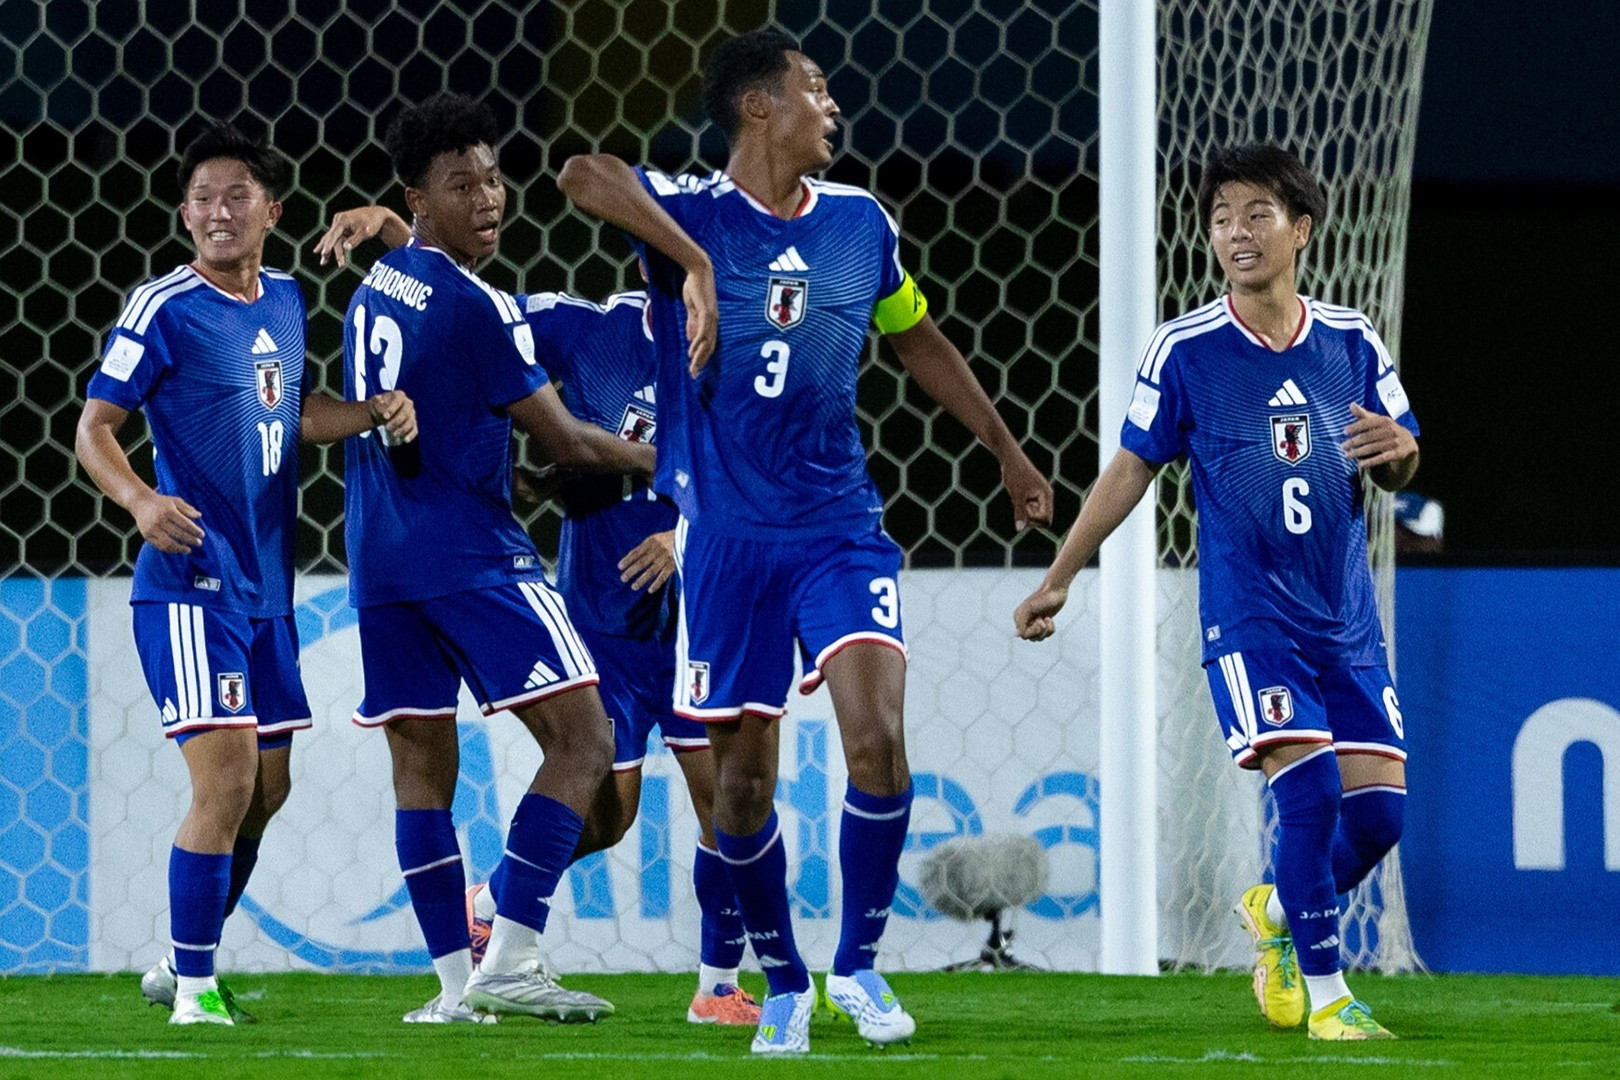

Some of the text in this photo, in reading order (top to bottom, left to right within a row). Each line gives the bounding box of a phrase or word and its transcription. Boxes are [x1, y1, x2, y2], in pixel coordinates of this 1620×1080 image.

[753, 340, 791, 398] 3
[257, 421, 283, 477] 18
[1282, 477, 1312, 535] 6
[868, 577, 900, 630] 3
[1382, 686, 1405, 740] 6
